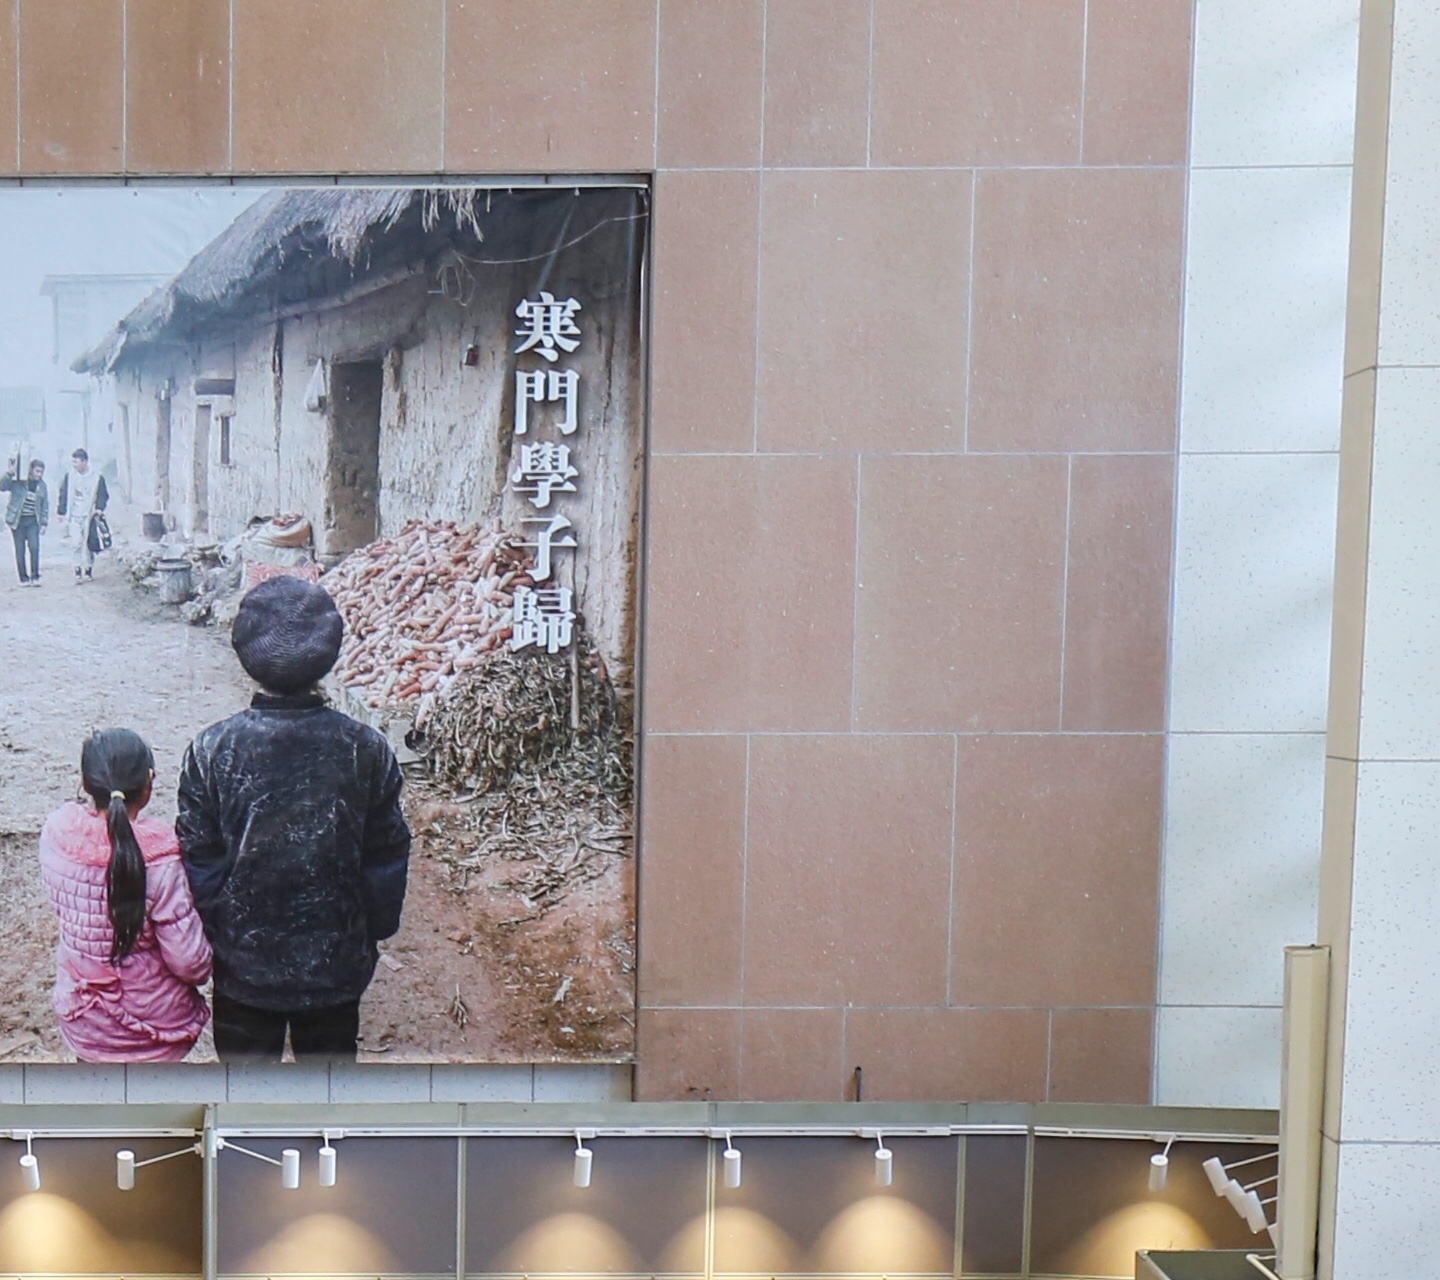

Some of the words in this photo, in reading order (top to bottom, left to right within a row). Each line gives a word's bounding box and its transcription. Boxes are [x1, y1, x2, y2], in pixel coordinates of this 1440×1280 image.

[511, 291, 583, 656] 寒門學子歸
